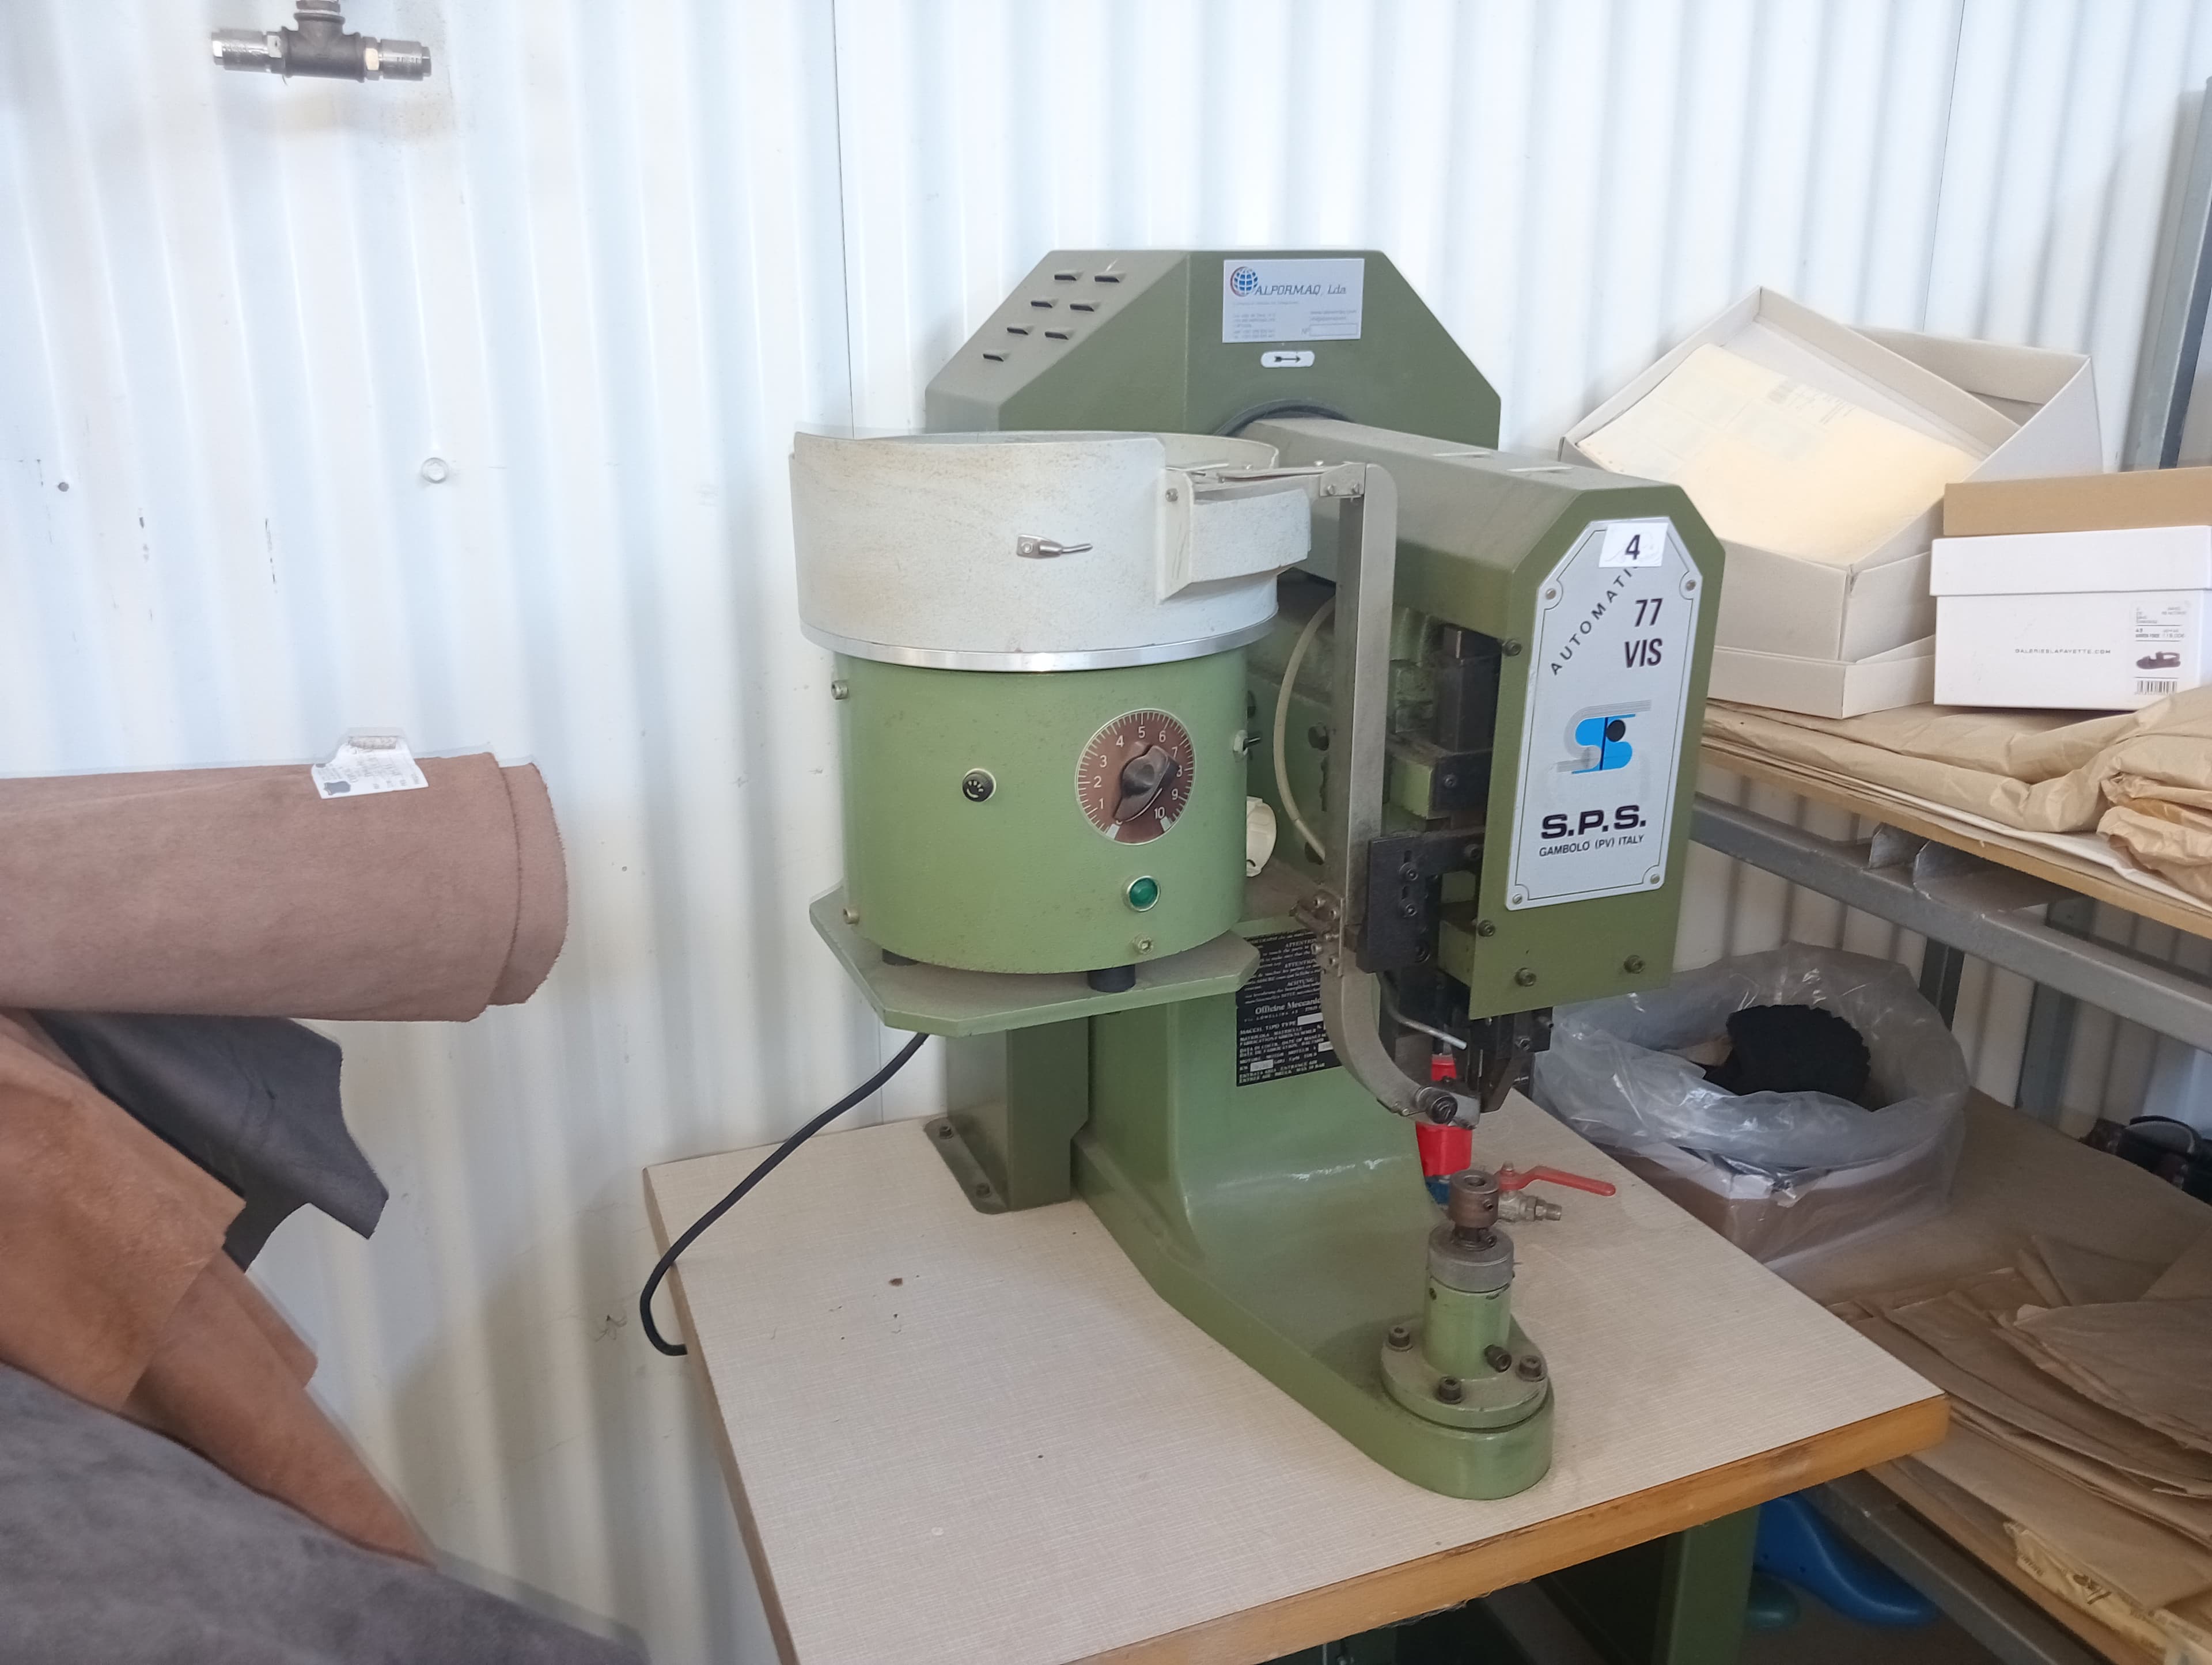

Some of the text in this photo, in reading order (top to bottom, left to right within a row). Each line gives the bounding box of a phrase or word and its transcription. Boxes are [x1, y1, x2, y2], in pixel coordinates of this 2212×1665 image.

[1327, 285, 1346, 294] Lda
[1625, 534, 1640, 560] 4
[1634, 598, 1663, 627] 77
[1551, 567, 1638, 676] AUTOMATI
[1624, 638, 1663, 668] VIS
[1138, 726, 1146, 738] 5
[1158, 730, 1166, 742] 6
[1116, 735, 1124, 748] 4
[1171, 746, 1178, 760] 7
[1100, 755, 1108, 768] 3
[1093, 776, 1101, 788] 2
[1171, 788, 1179, 801] 9
[1099, 798, 1104, 809] 1
[1154, 807, 1165, 819] 10
[1541, 805, 1646, 839] S.P.S.
[1595, 837, 1615, 849] (PV)
[1619, 835, 1644, 845] ITALY
[1287, 998, 1320, 1009] Meccanic
